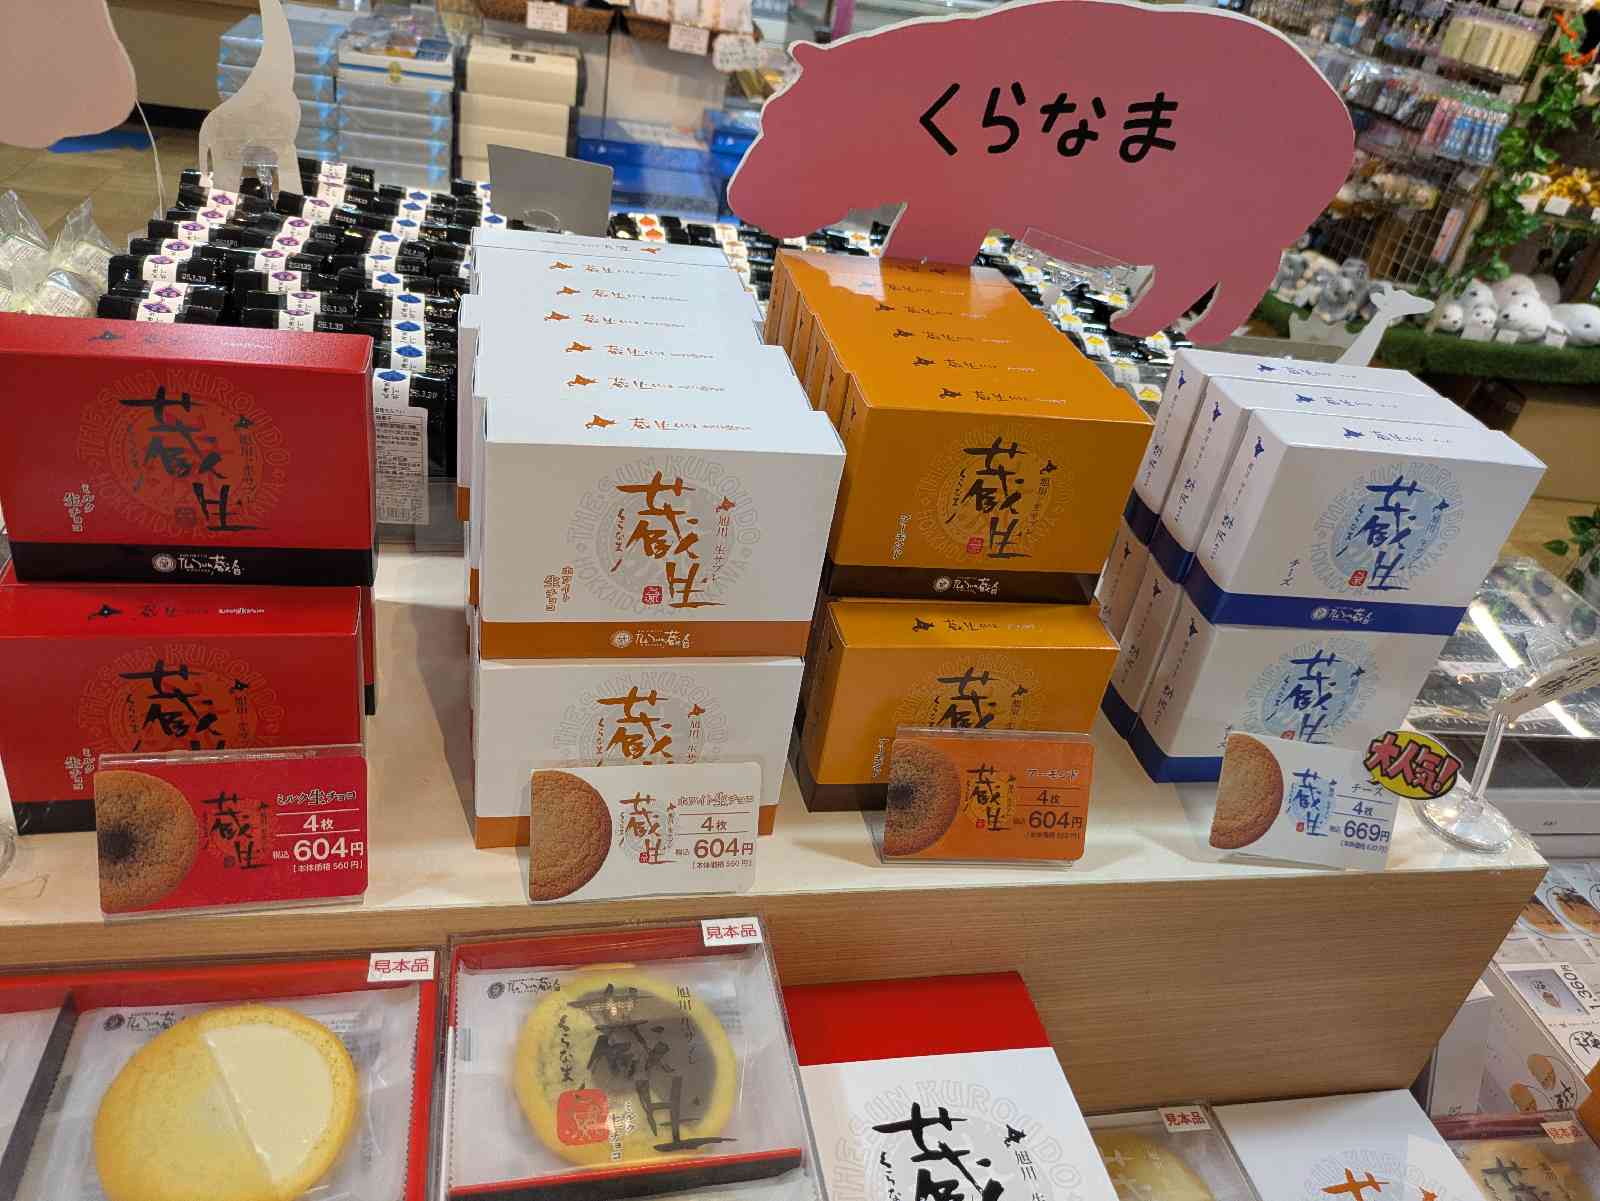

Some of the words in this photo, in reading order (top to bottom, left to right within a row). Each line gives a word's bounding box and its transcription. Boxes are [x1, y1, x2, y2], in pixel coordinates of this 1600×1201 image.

[918, 81, 1179, 163] くらなま
[119, 385, 272, 532] 蔵生
[963, 436, 1032, 558] 蔵生
[616, 470, 727, 609] 蔵生
[1366, 474, 1424, 590] 蔵生
[1364, 731, 1461, 795] 大人気!
[303, 814, 334, 832] 4枚
[700, 816, 728, 832] 4枚
[1028, 809, 1083, 830] 604円
[1343, 819, 1391, 843] 669円
[293, 836, 364, 862] 604円
[693, 837, 754, 859] 604円
[705, 924, 758, 940] 見本品
[374, 957, 430, 975] 見本品
[1164, 1111, 1206, 1128] 見本品
[1014, 1149, 1038, 1182] 旭川
